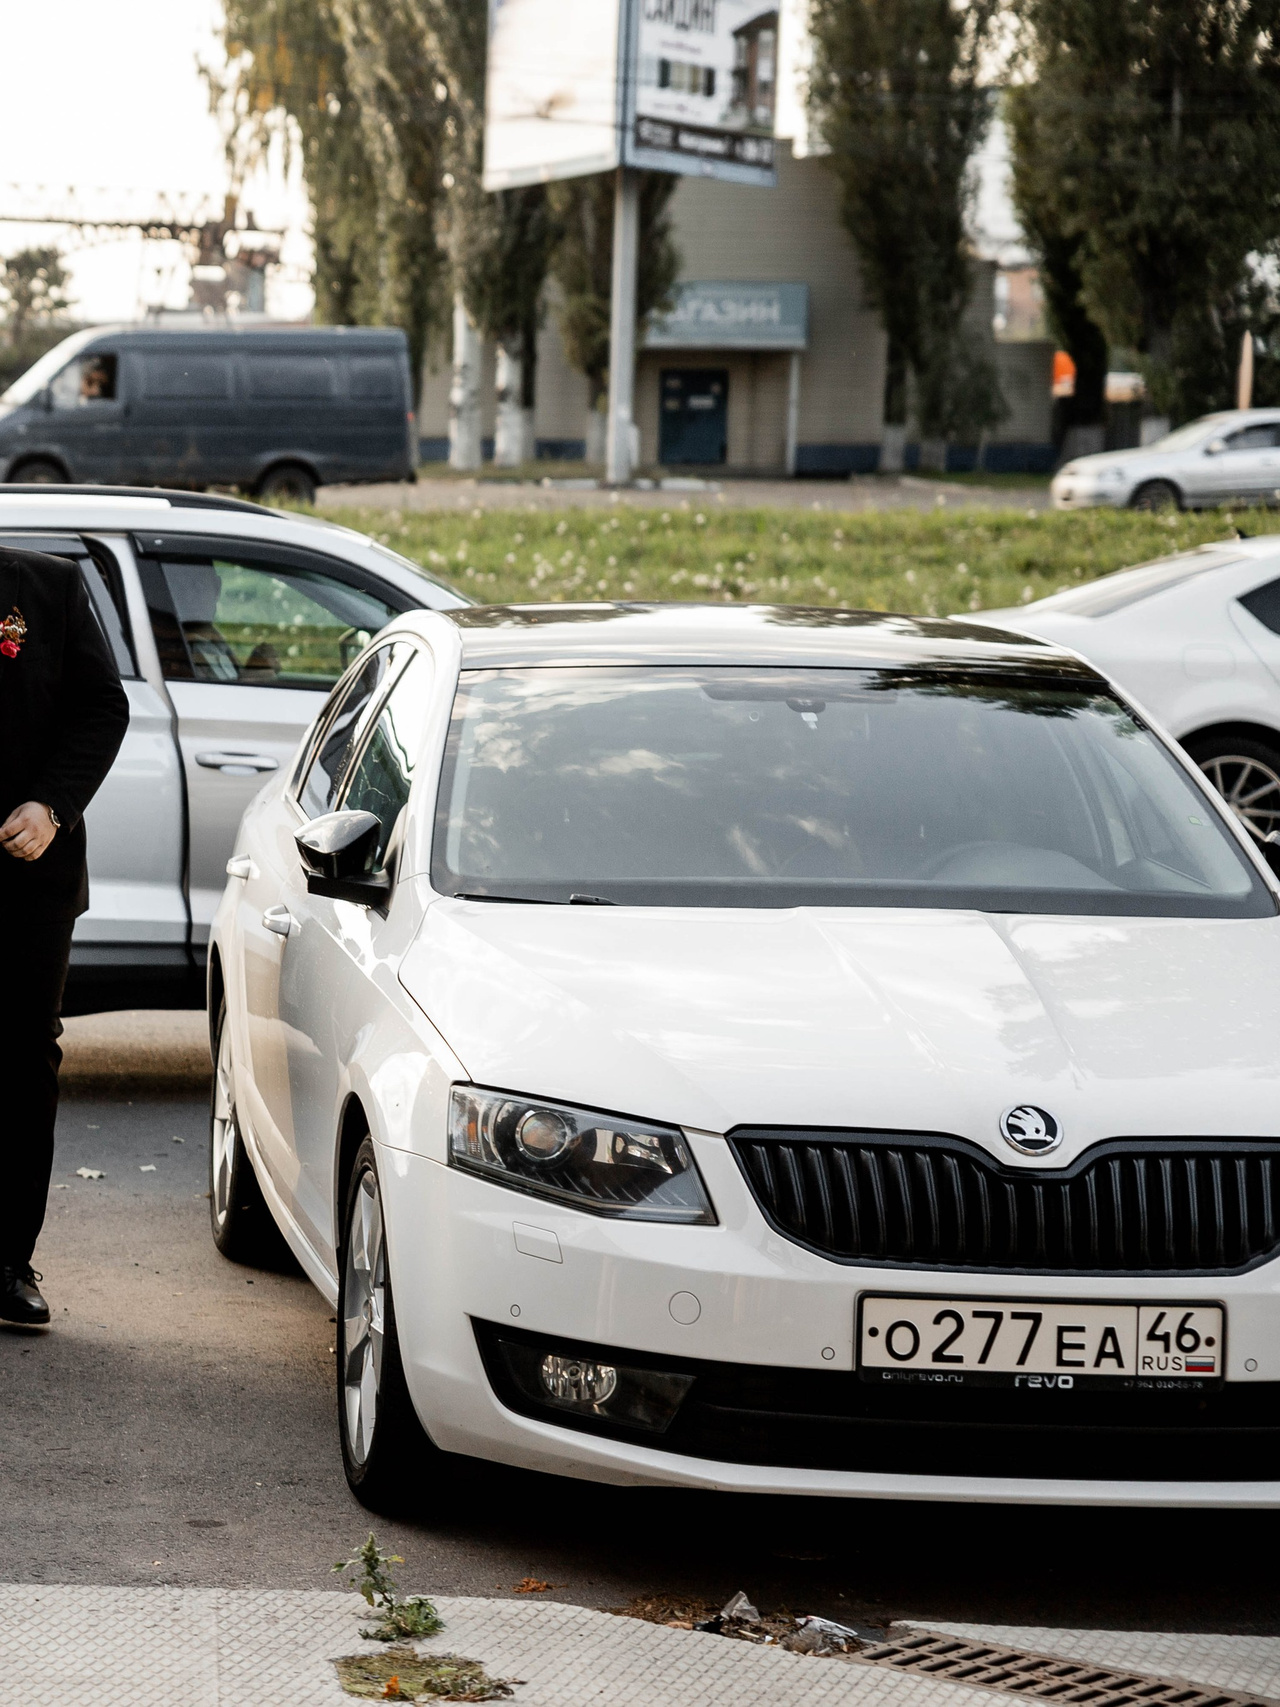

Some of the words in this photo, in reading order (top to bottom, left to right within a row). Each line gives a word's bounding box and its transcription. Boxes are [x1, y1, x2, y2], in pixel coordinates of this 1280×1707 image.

[1146, 1311, 1201, 1354] 46
[1141, 1355, 1183, 1372] RUS
[1014, 1374, 1074, 1389] revo
